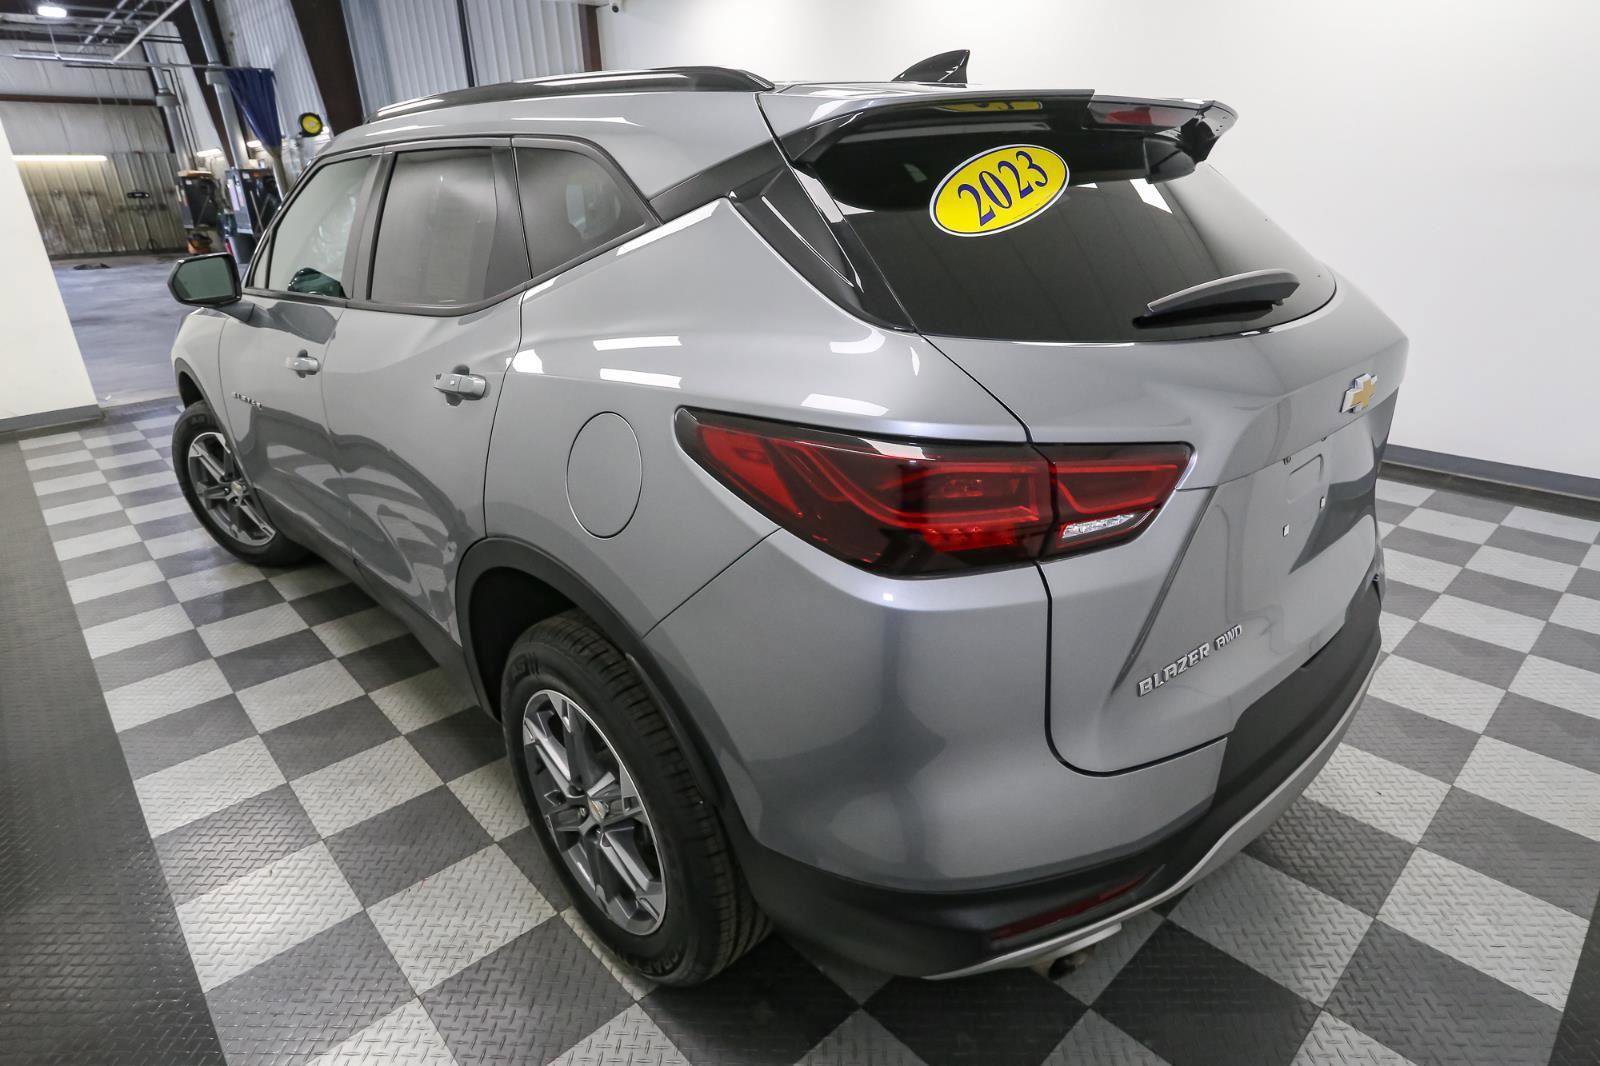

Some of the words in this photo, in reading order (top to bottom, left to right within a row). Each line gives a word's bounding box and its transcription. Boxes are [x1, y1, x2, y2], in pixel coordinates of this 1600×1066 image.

[957, 150, 1048, 227] 2023
[1137, 642, 1210, 697] BLAZER
[1214, 624, 1243, 650] AWD
